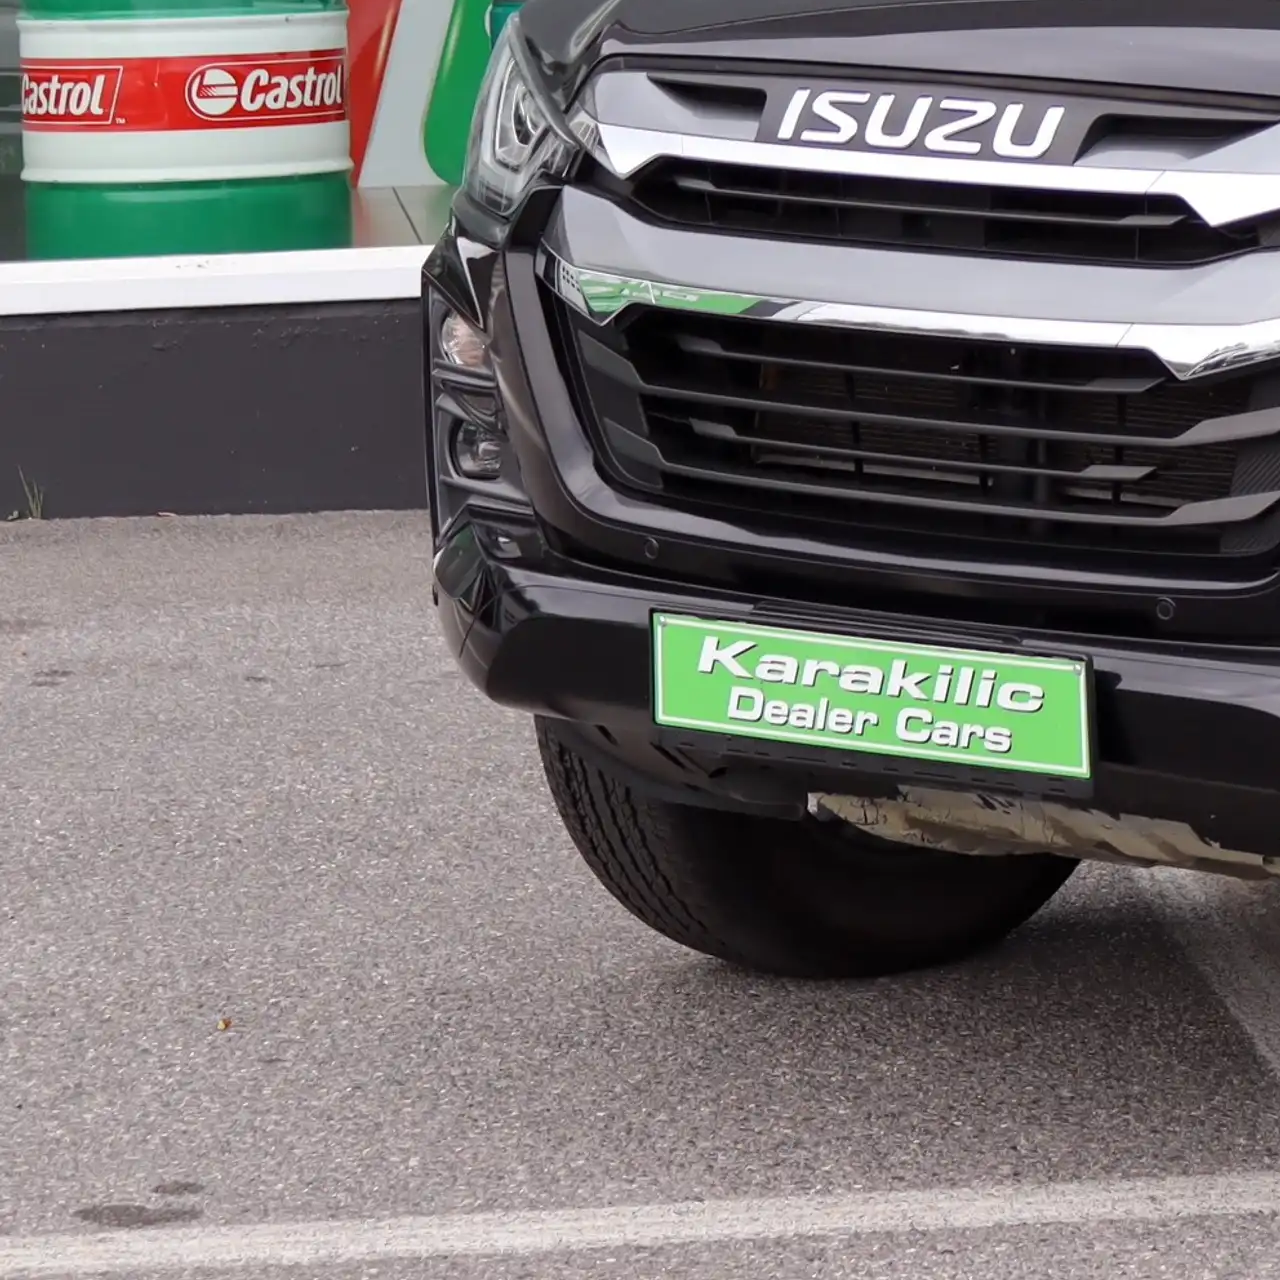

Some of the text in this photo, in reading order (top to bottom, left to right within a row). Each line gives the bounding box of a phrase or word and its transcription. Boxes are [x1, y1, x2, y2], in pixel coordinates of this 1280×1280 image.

[21, 73, 107, 116] Castrol
[239, 66, 344, 112] Castrol
[777, 87, 1067, 158] ISUZU
[696, 634, 1046, 714] Karakilic
[726, 686, 1013, 754] Dealer Cars
